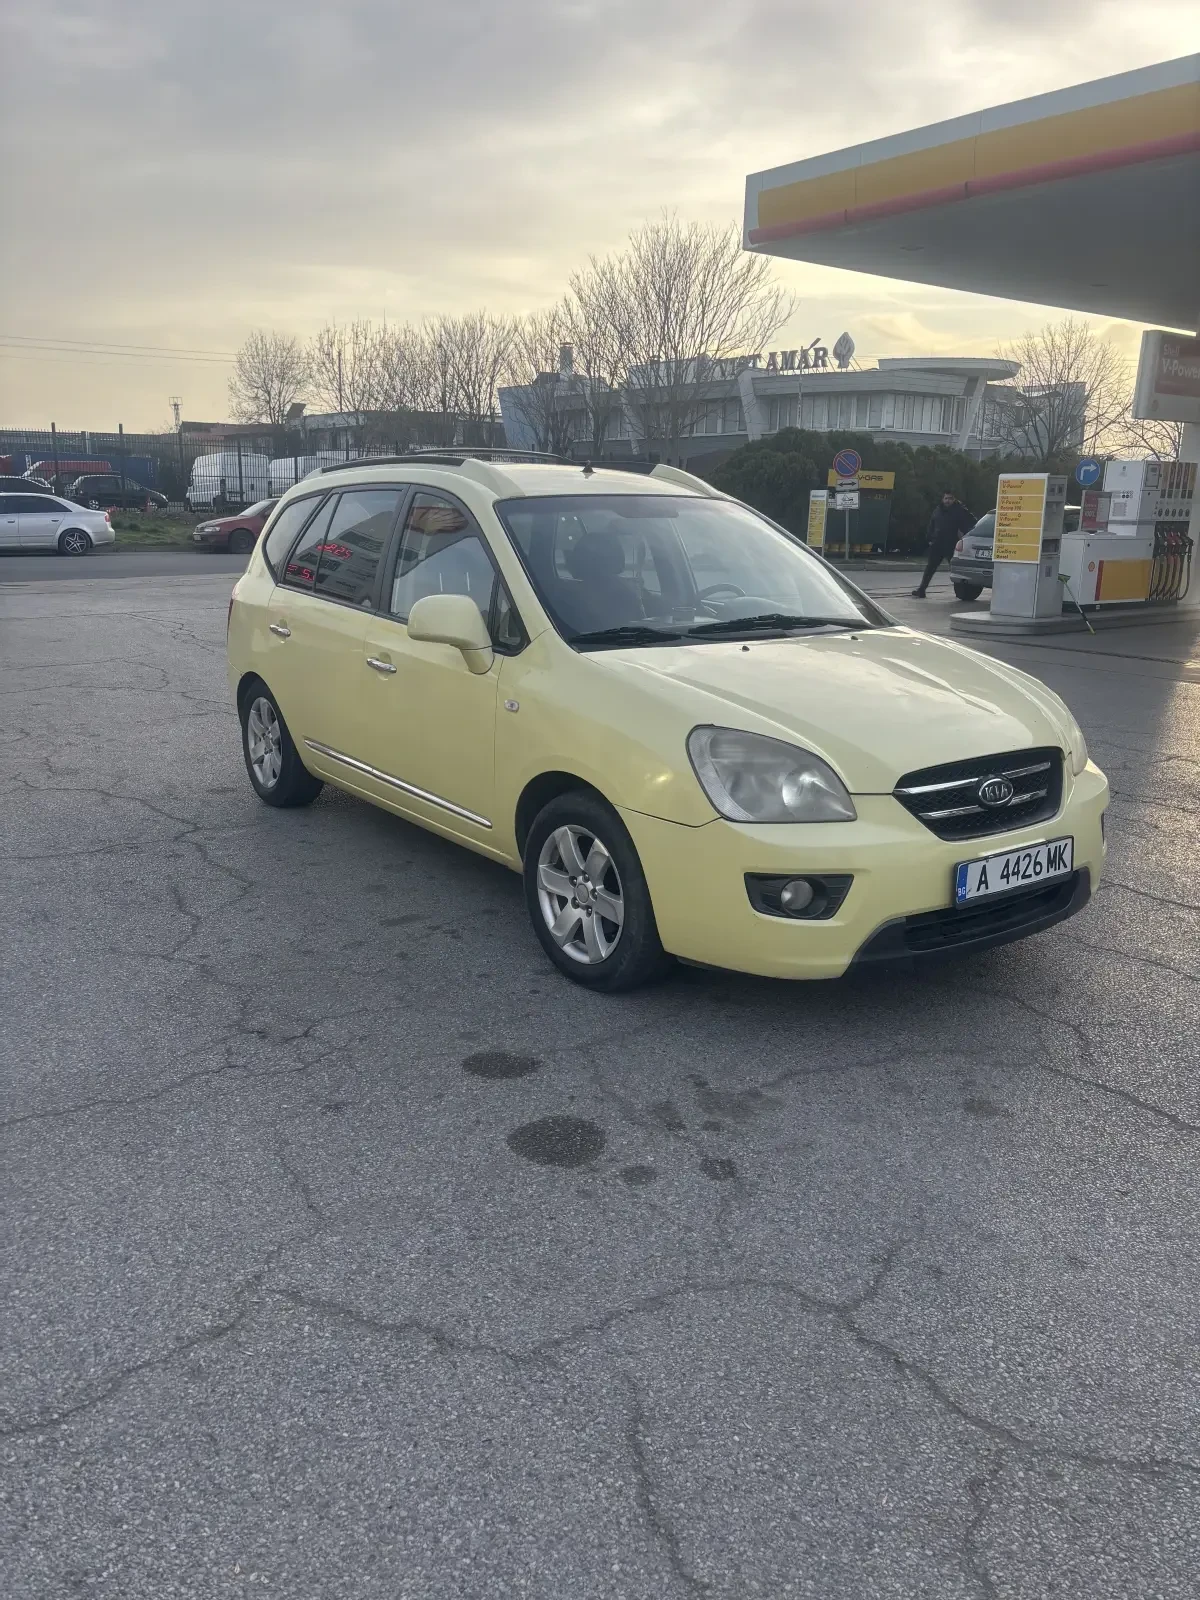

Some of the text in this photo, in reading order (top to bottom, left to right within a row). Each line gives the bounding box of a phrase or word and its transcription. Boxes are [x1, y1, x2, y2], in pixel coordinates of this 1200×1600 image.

[984, 783, 1009, 799] KIA
[976, 843, 1068, 892] A 4426 MK
[957, 886, 966, 897] BG
